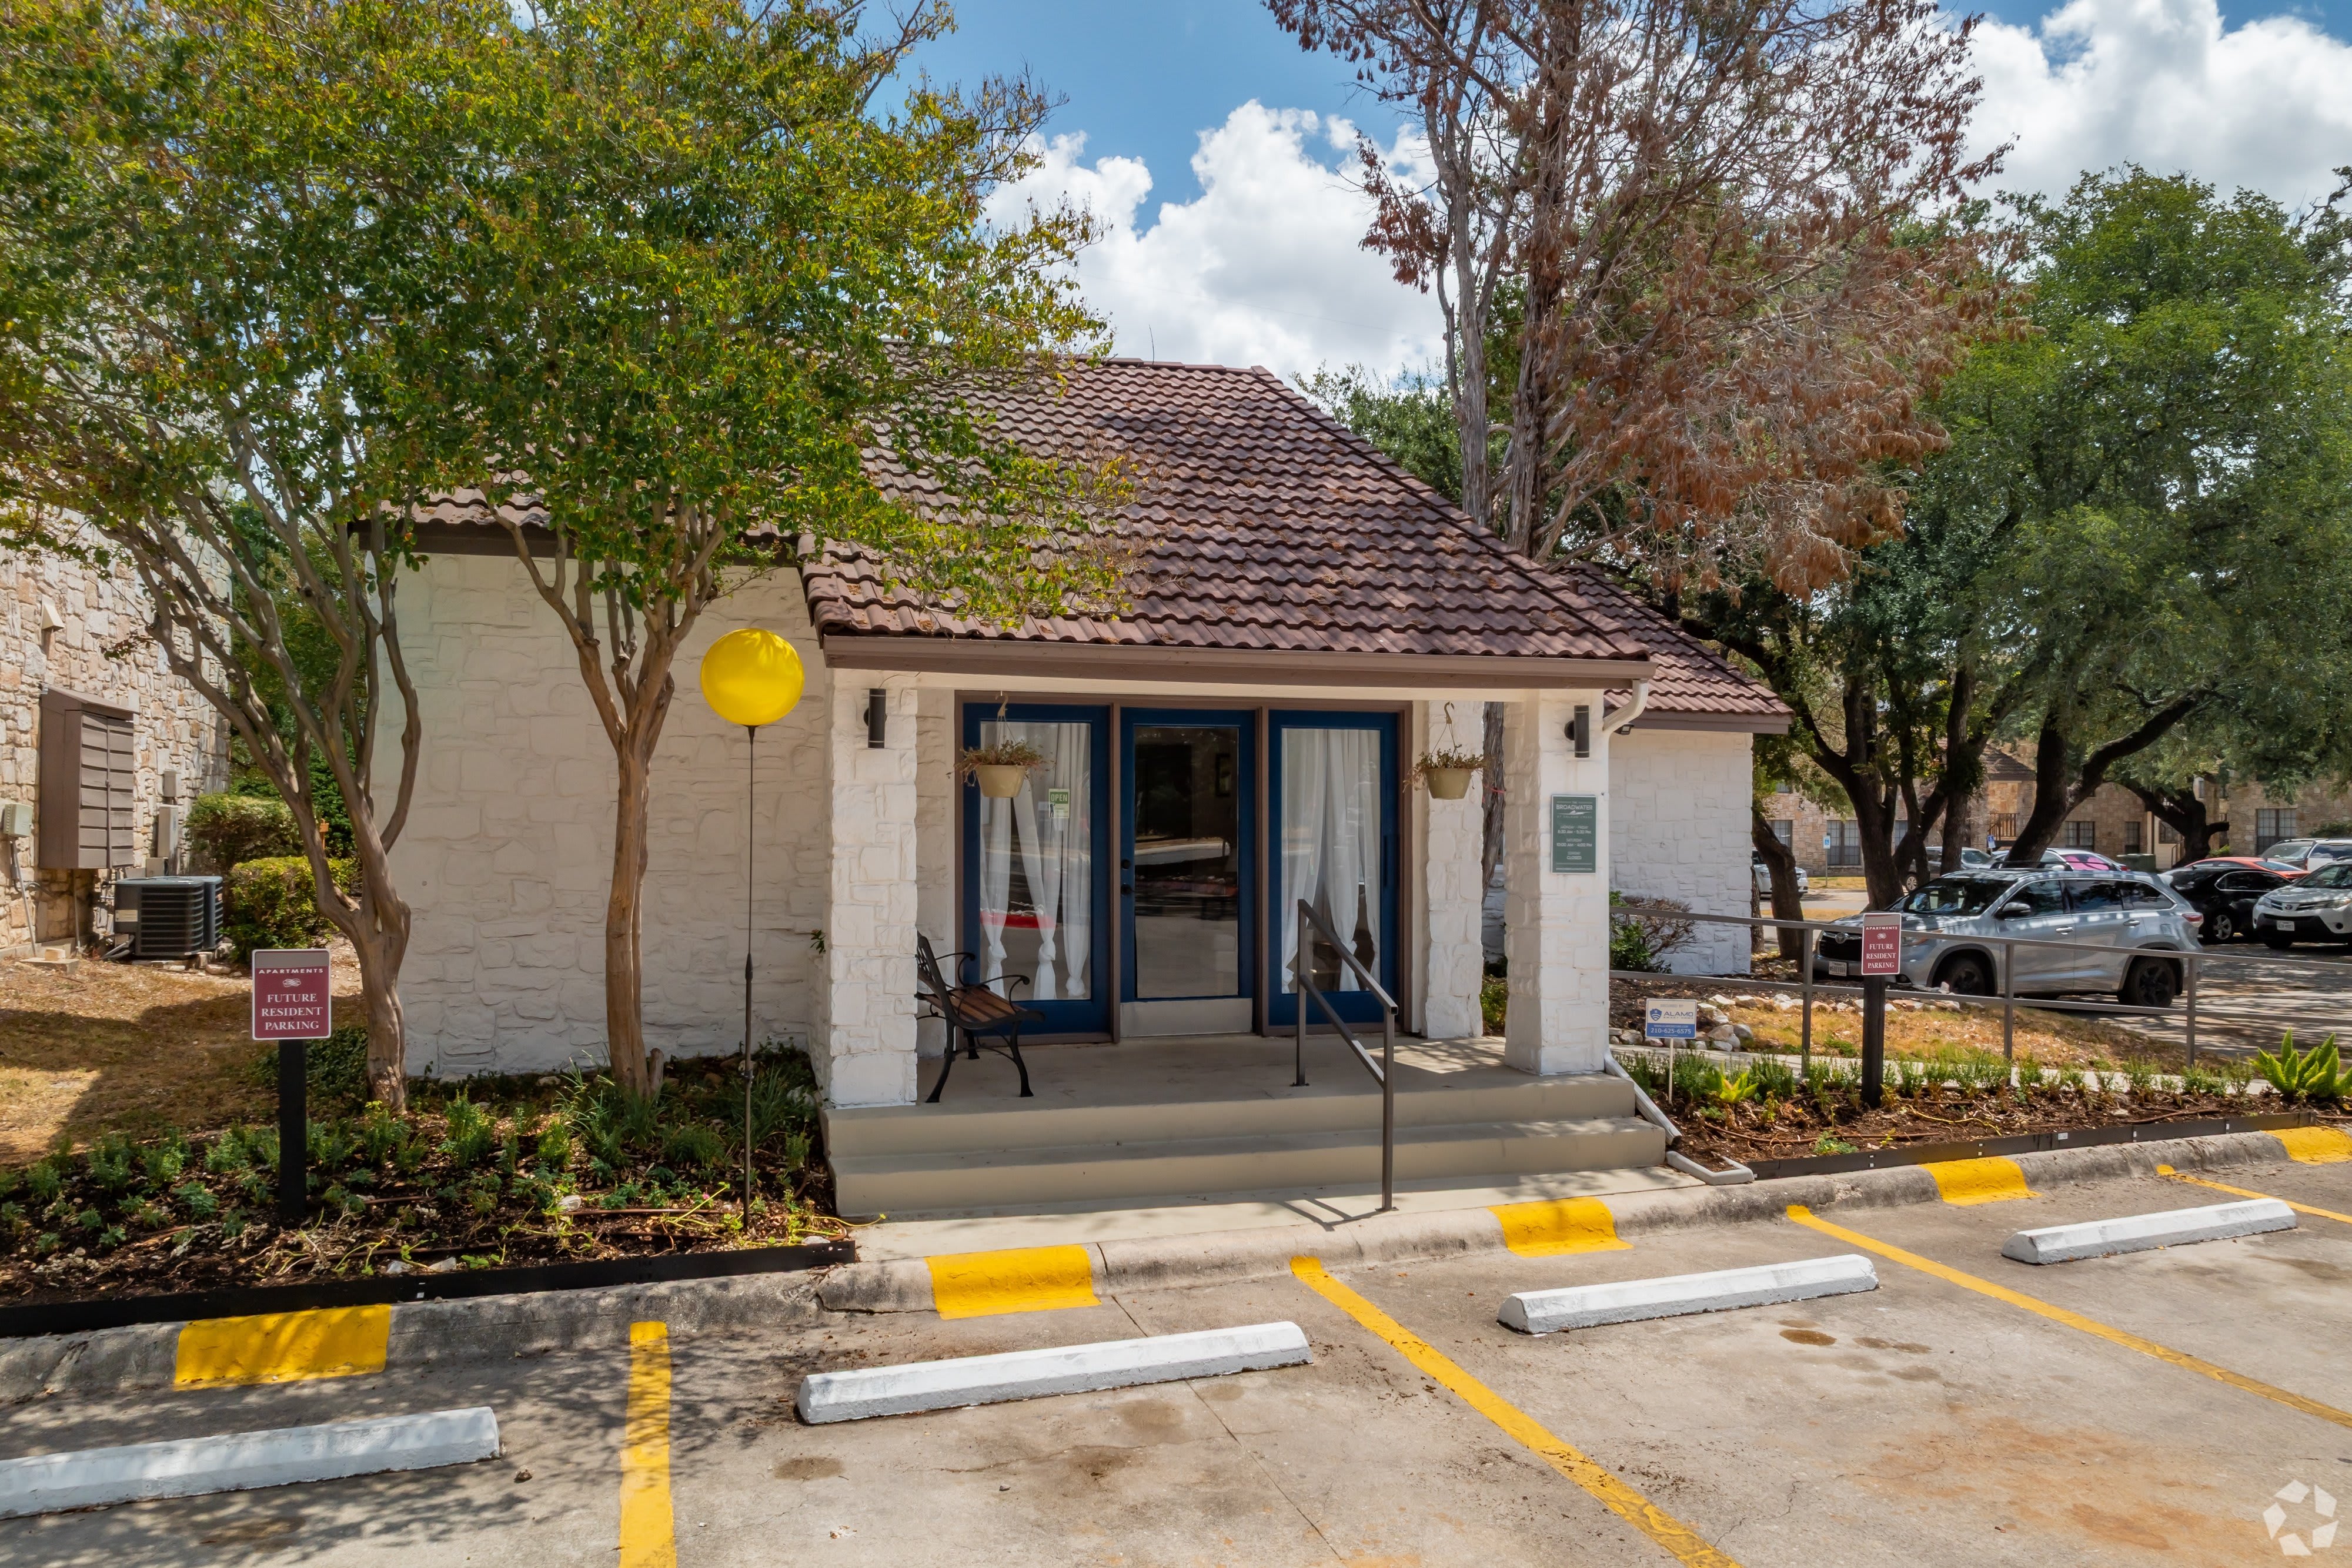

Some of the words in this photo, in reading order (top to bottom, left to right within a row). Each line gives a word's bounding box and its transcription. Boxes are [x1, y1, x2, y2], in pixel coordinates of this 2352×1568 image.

[267, 994, 317, 1002] FUTURE
[262, 1007, 323, 1017] RESIDENT
[265, 1021, 319, 1030] PARKING
